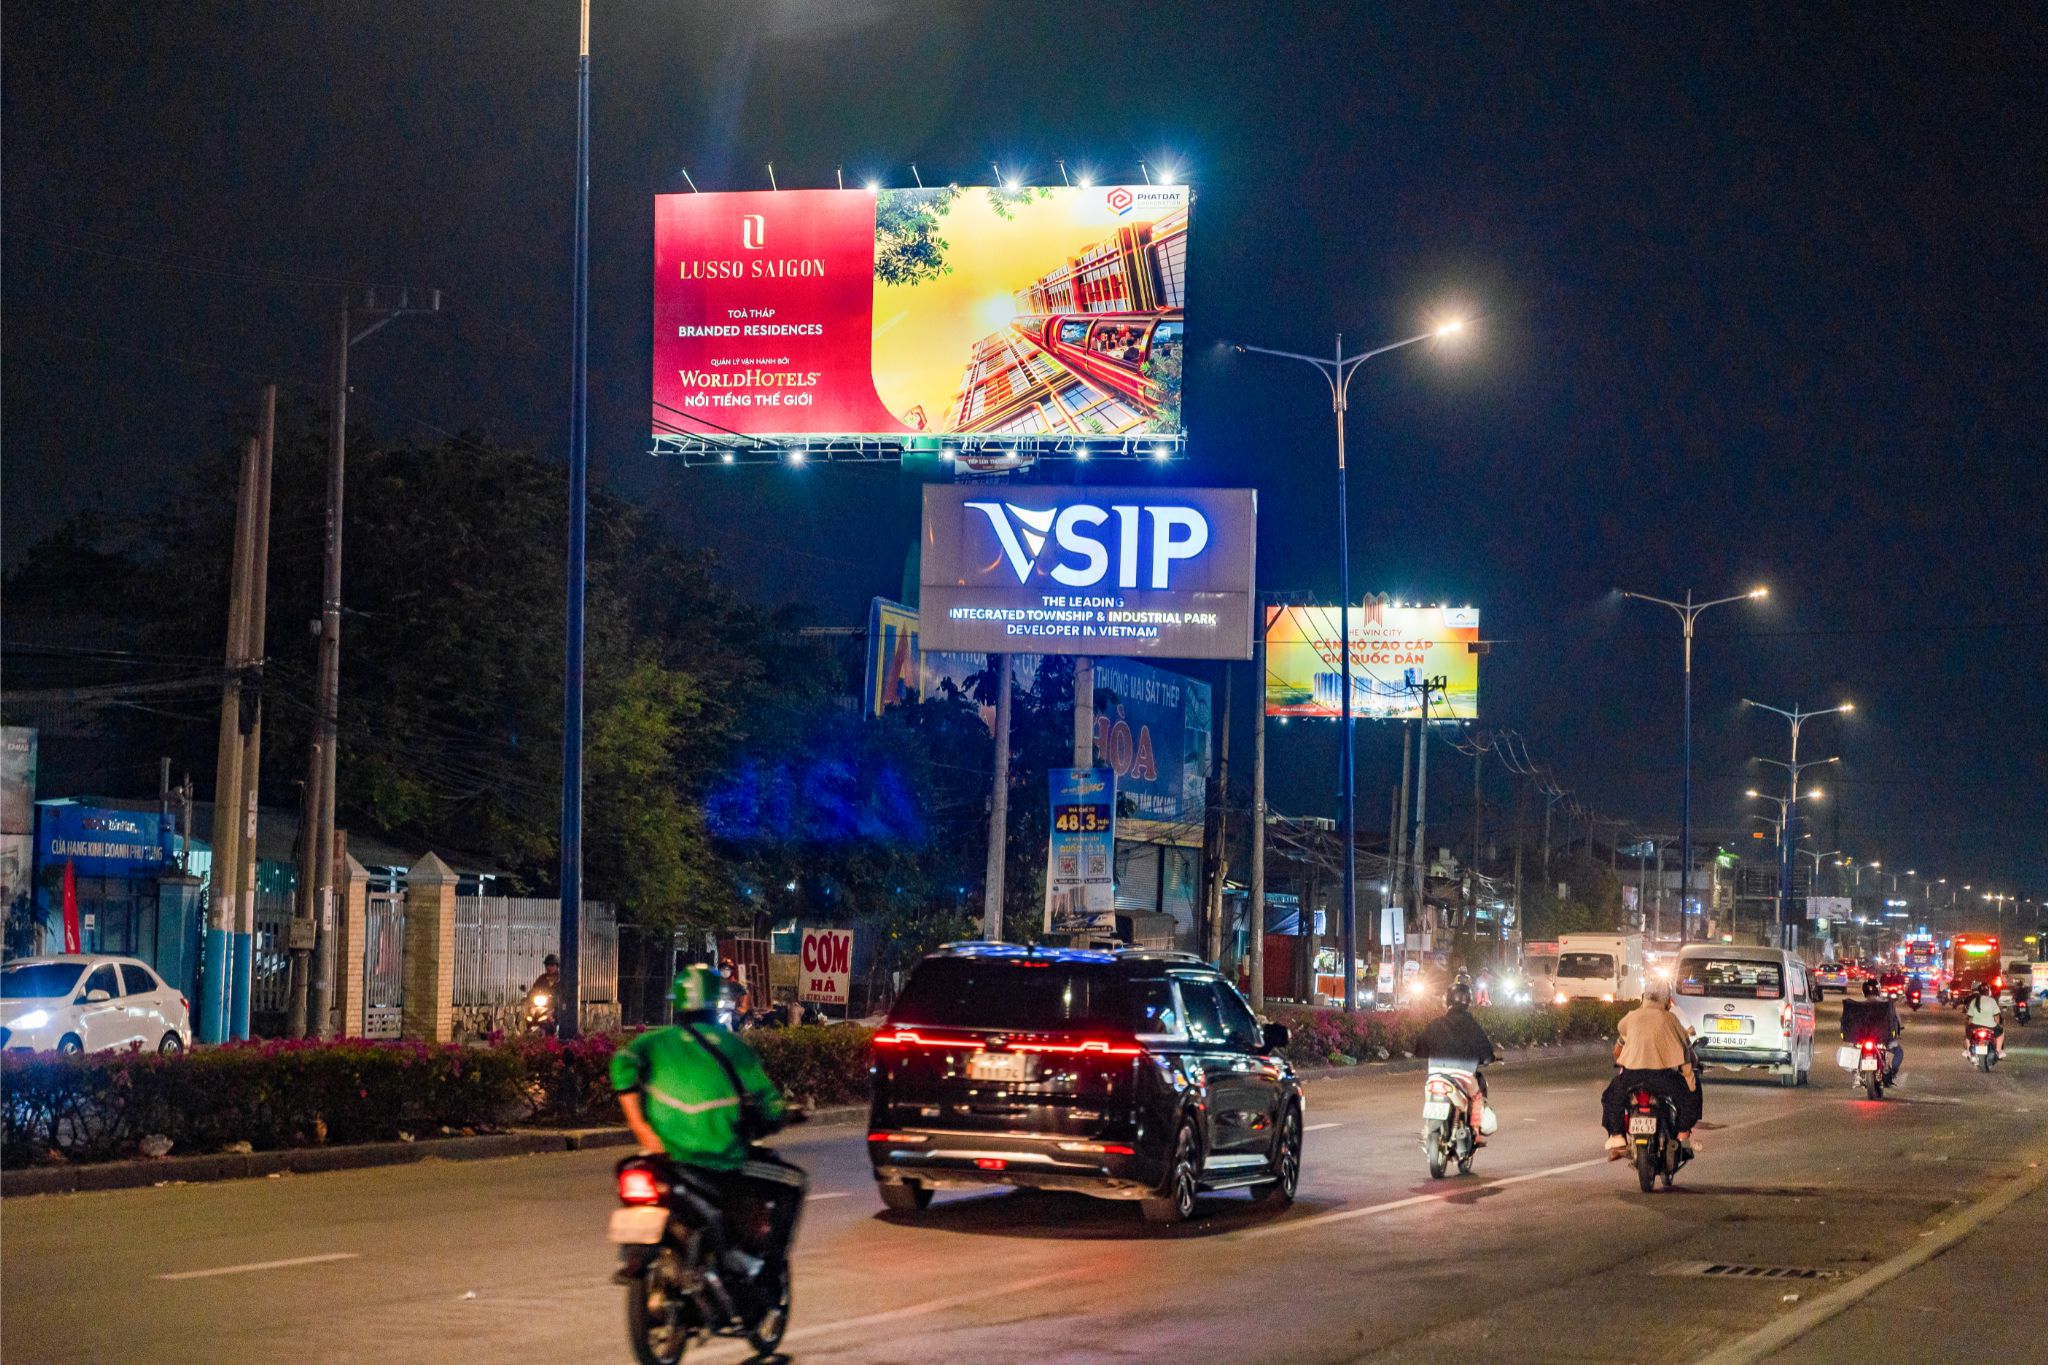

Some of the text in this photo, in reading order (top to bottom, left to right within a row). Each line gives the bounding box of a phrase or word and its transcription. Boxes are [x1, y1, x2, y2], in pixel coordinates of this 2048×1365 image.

[680, 258, 825, 279] LUSSO SAIGON
[749, 307, 776, 318] THÁP
[678, 324, 823, 337] BRANDED RESIDENCES
[685, 390, 813, 407] NỔI TIẾNG THẾ GIỚI
[963, 501, 1209, 589] VSIP
[1042, 596, 1125, 608] THE LEADING
[949, 608, 1218, 626] INTEGRATED TOWNSHIP & INDUSTRIAL PARK
[1007, 624, 1159, 638] DEVELOPER IN VIETNAM
[1383, 629, 1402, 637] CITY
[1371, 639, 1400, 651] CAO
[1404, 636, 1434, 651] CẤP
[1350, 650, 1390, 666] QUỐC
[1394, 652, 1425, 665] DÂN
[1056, 814, 1096, 831] 48.3
[87, 841, 104, 857] KINH
[105, 843, 129, 859] DOANH
[803, 931, 850, 973] CƠM
